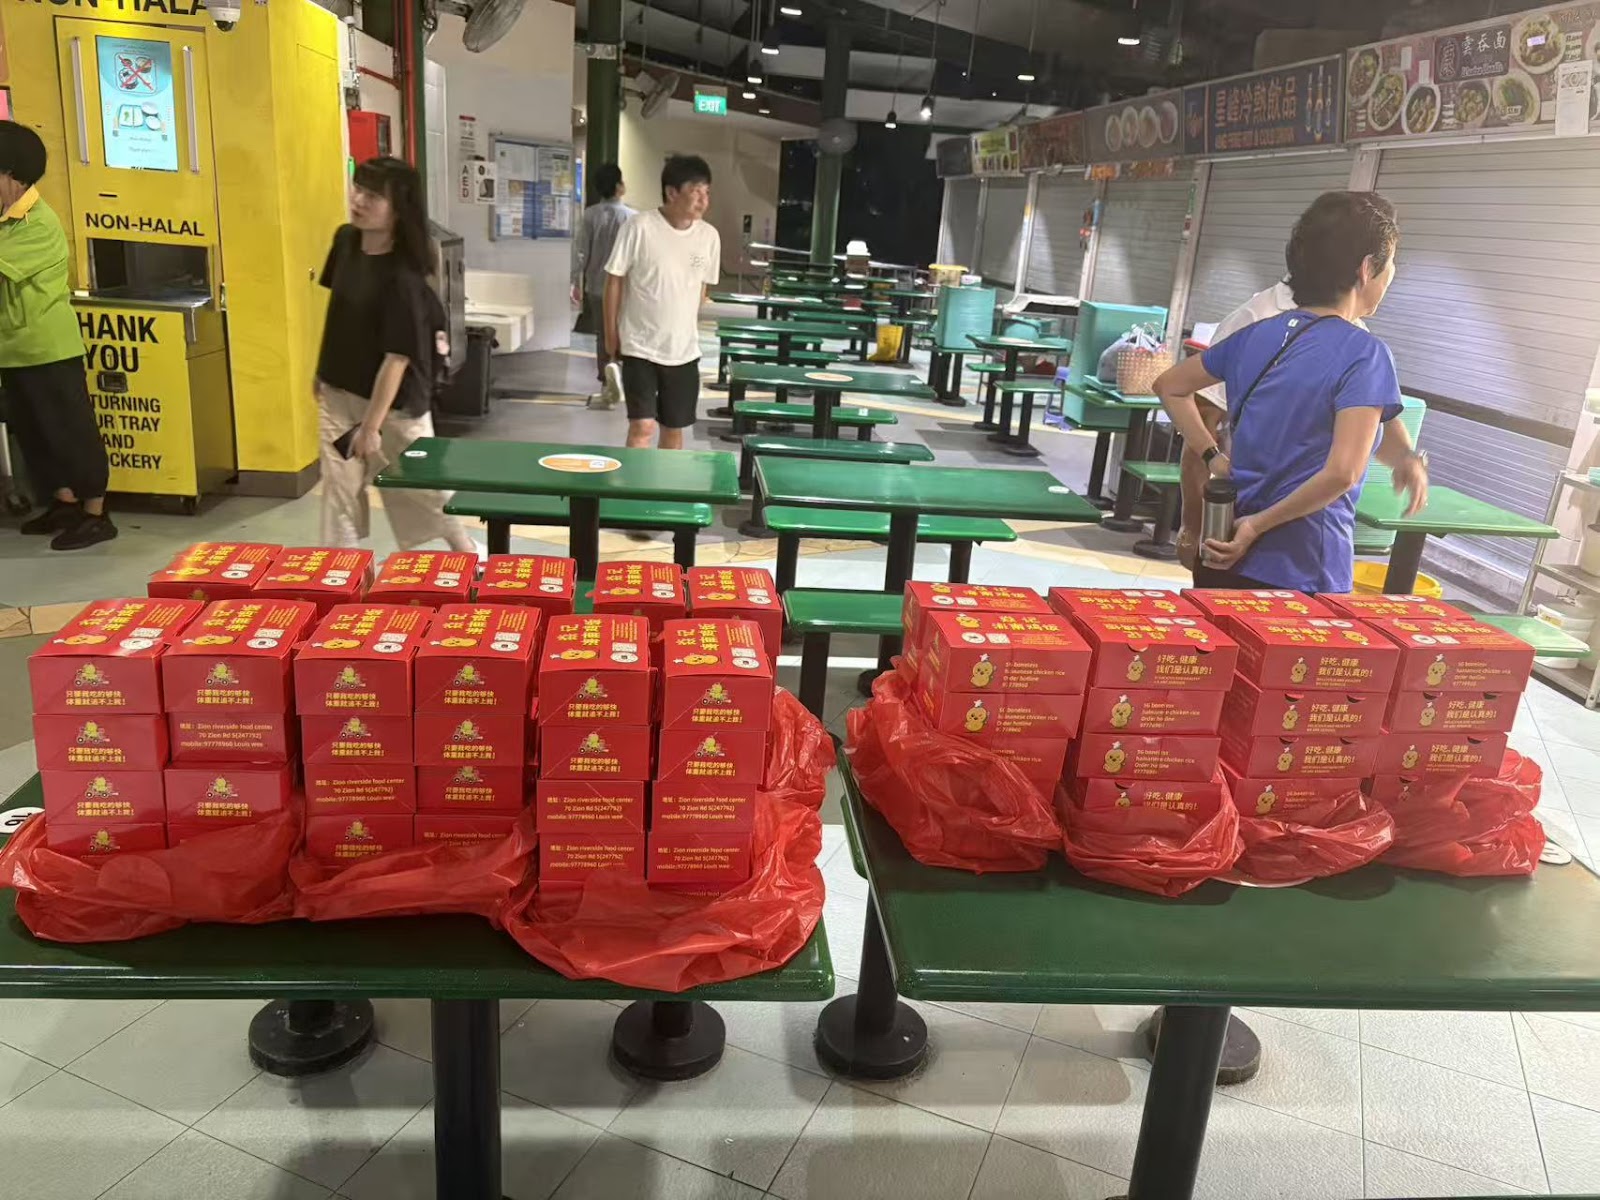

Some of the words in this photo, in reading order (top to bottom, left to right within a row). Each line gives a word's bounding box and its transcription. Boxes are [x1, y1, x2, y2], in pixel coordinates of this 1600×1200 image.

[699, 100, 721, 113] EXIT
[86, 213, 205, 236] NON-HALAL
[77, 312, 159, 343] HANK
[85, 344, 139, 372] YOU
[90, 394, 161, 413] TURNING
[119, 415, 160, 432] TRAY
[102, 434, 135, 449] AND
[110, 453, 162, 469] CKERY
[1320, 657, 1360, 666] 好吃、健康
[1311, 704, 1349, 712] 好吃、健康
